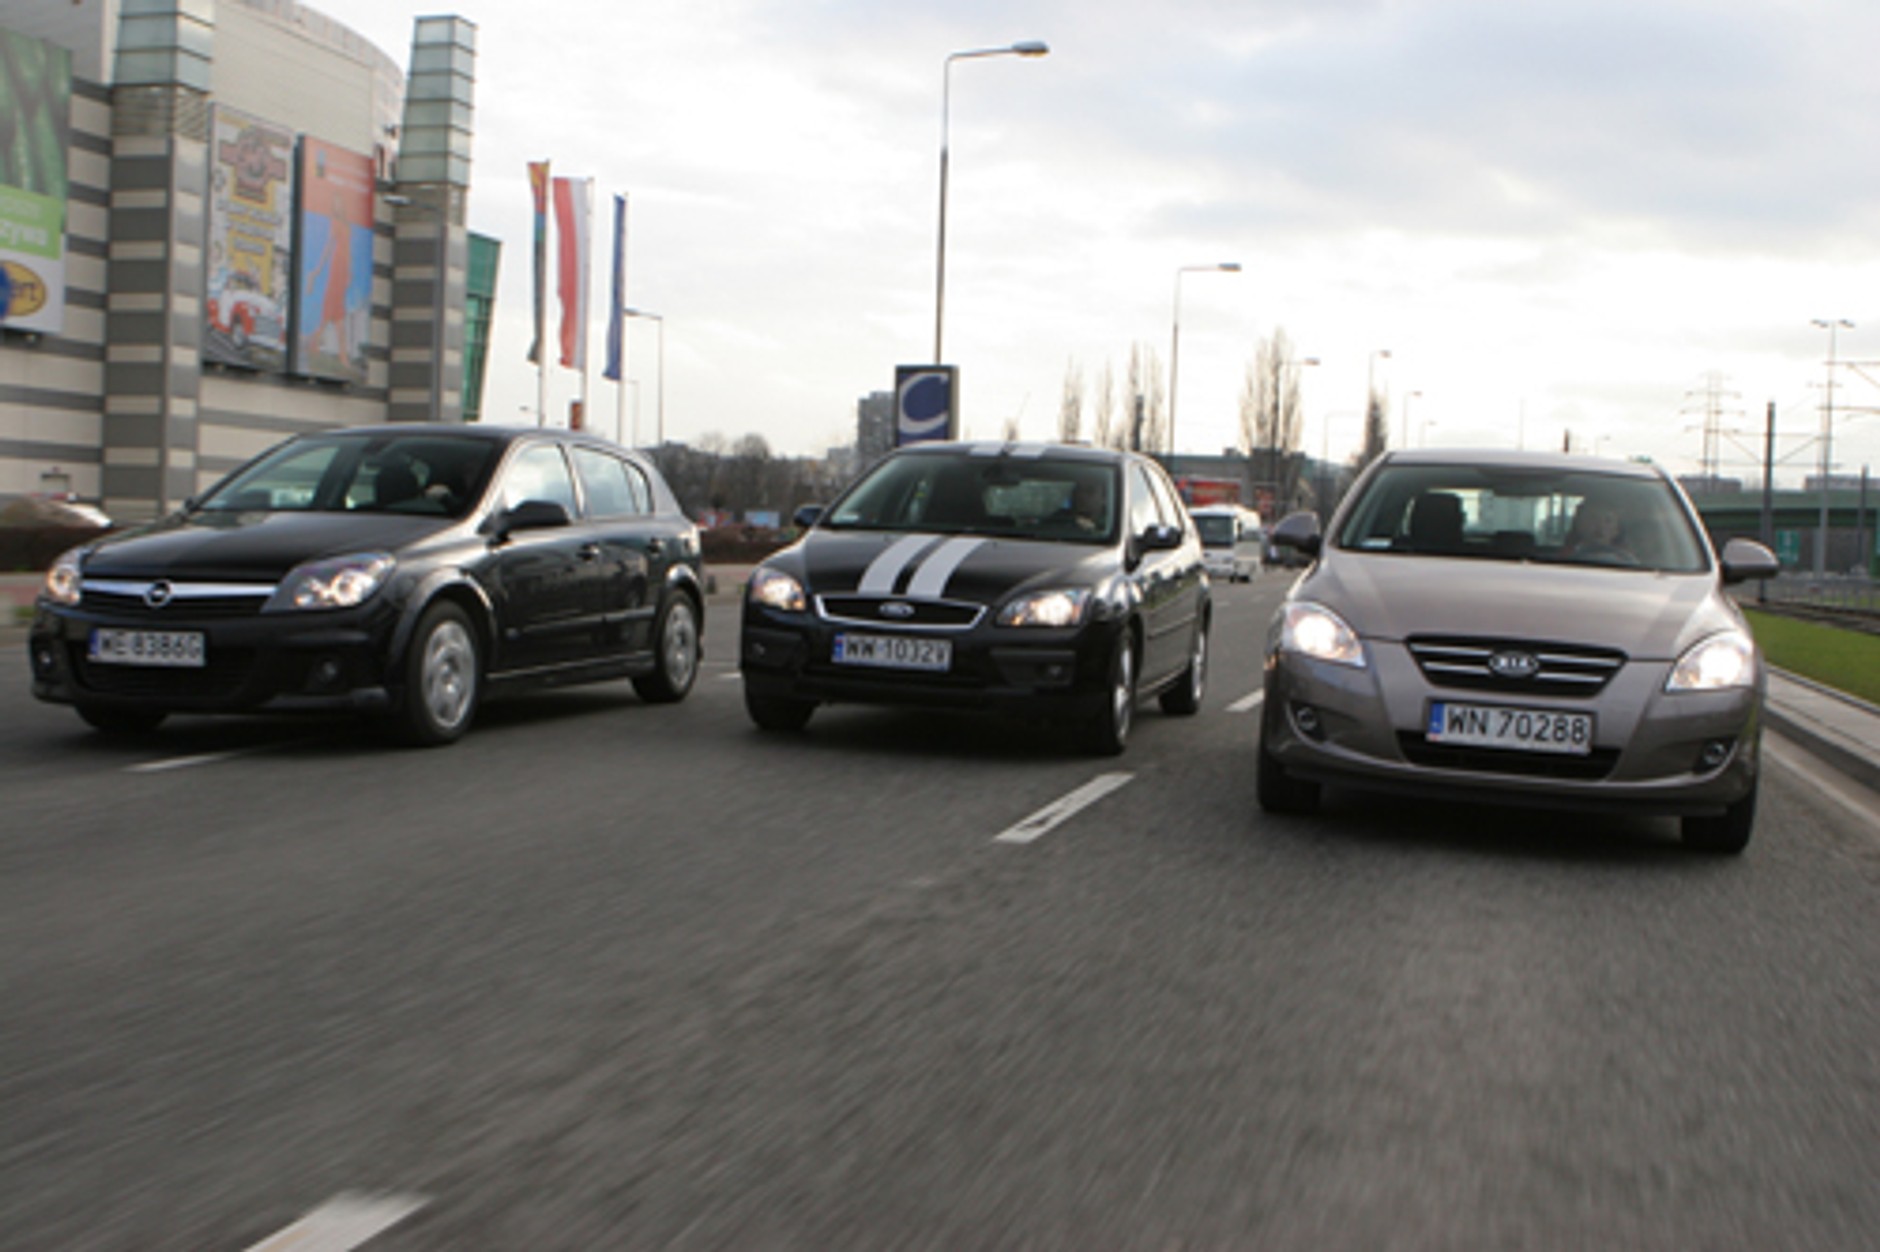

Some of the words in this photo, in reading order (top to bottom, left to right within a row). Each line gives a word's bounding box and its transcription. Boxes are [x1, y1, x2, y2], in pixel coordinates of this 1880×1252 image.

[846, 635, 876, 659] WW
[1447, 707, 1489, 736] WN
[1496, 710, 1586, 745] 70288
